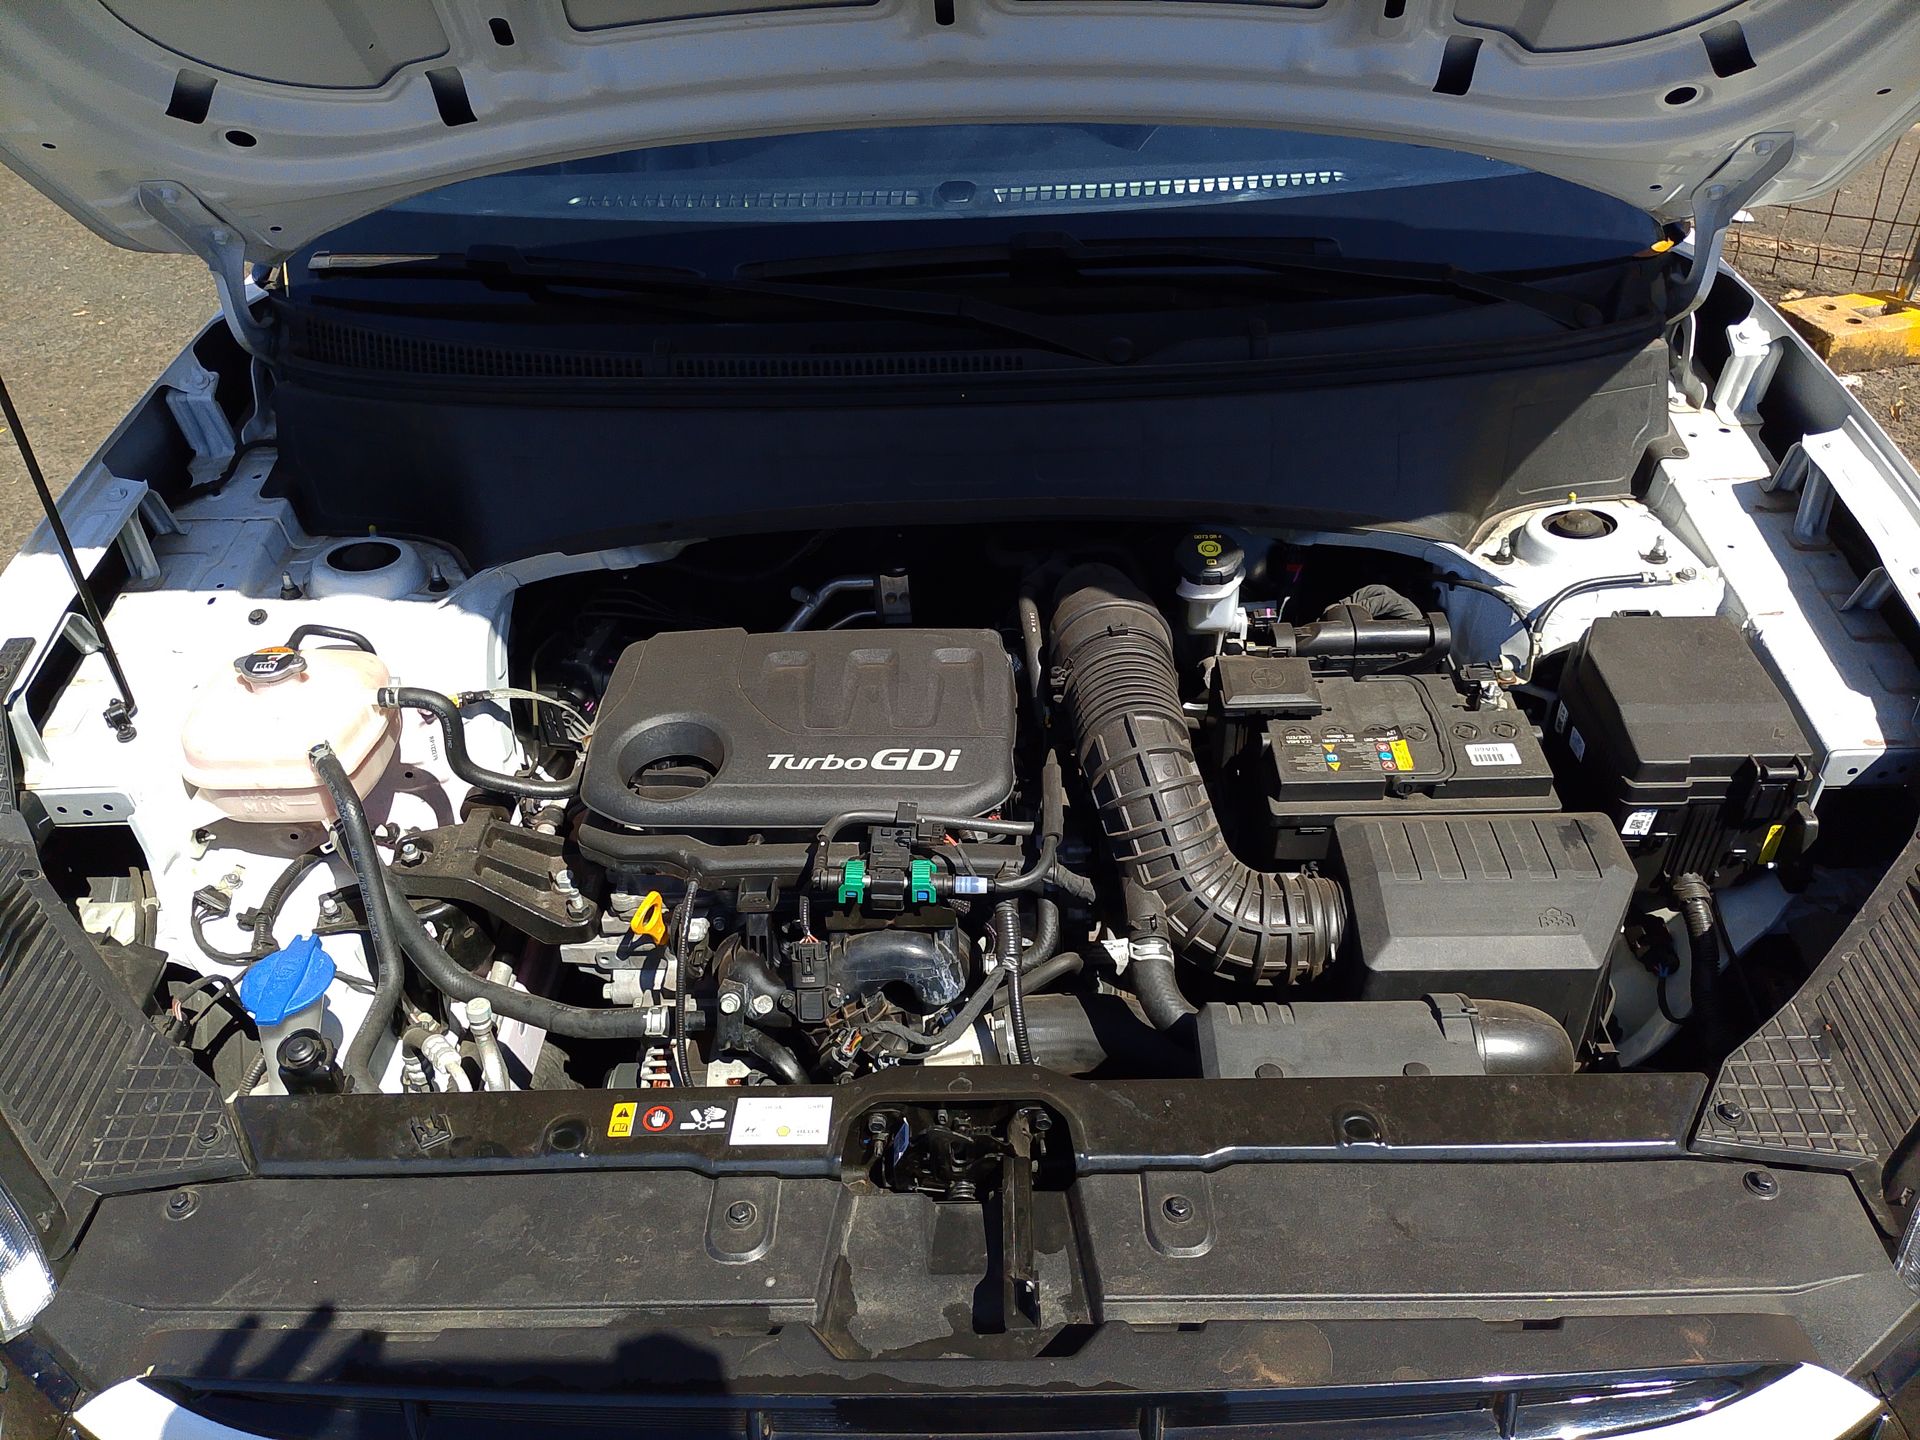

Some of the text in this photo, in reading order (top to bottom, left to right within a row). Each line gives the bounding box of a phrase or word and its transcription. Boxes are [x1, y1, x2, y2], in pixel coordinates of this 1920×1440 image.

[767, 748, 962, 772] Turbo GDi
[243, 801, 287, 814] MIN
